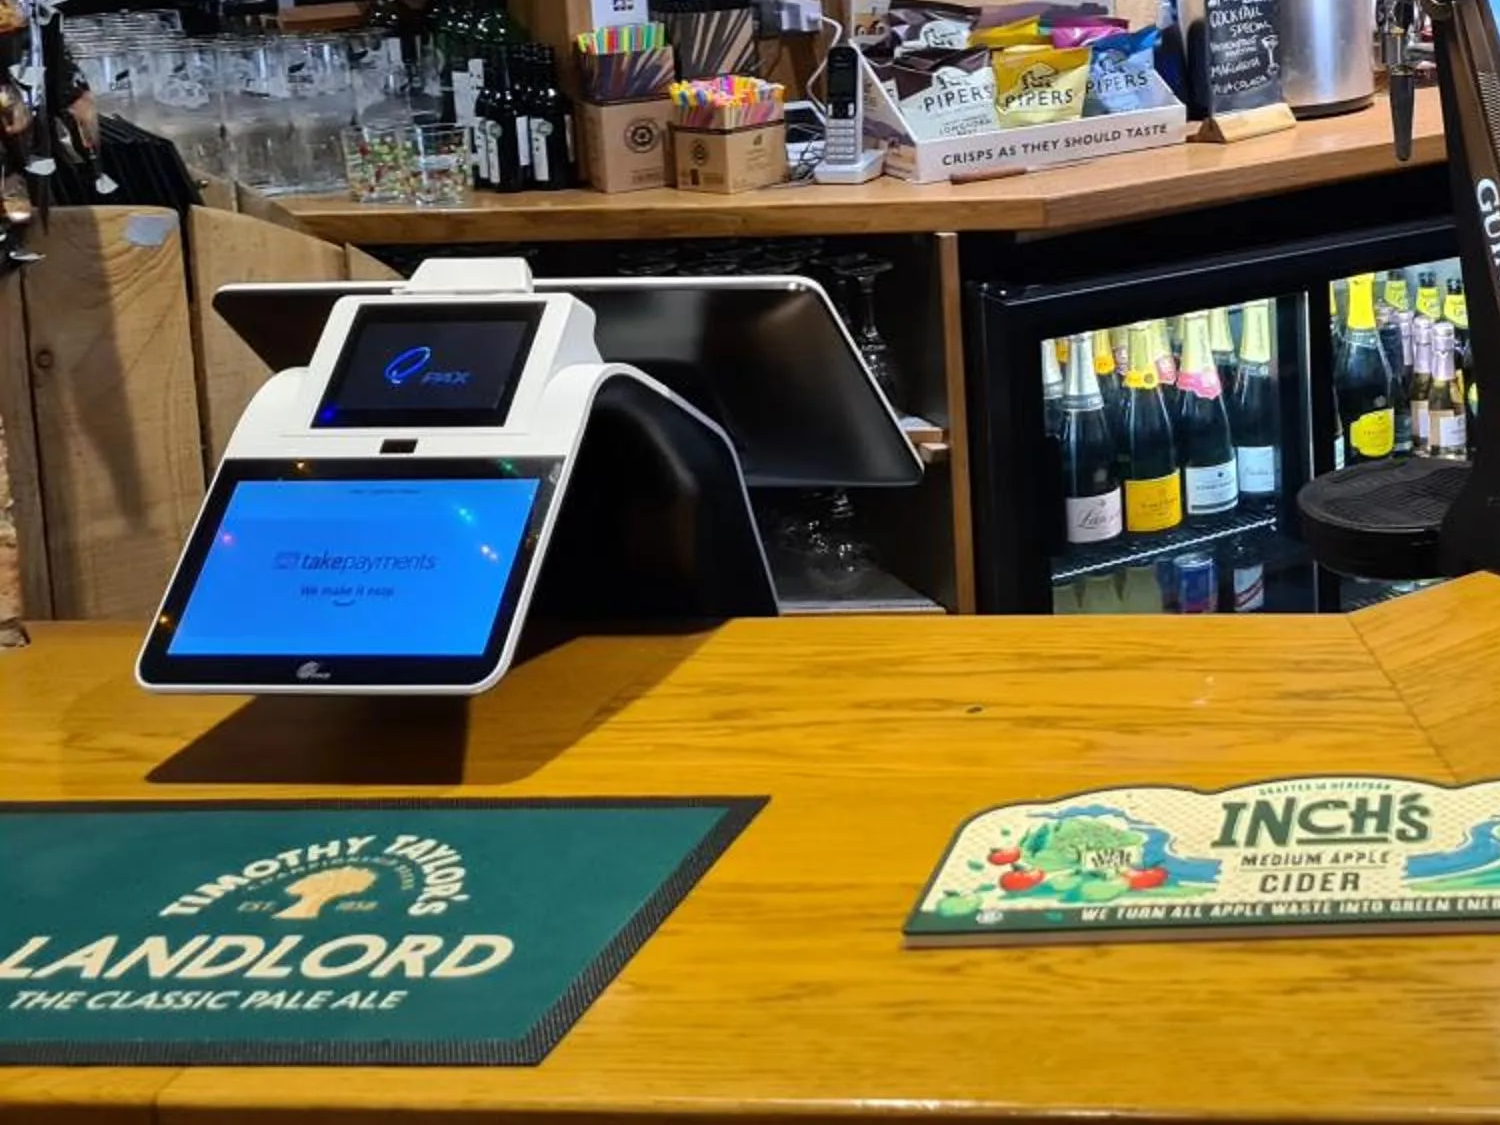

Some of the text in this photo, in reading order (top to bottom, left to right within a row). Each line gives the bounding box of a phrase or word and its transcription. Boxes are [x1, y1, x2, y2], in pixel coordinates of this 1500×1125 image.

[1086, 73, 1149, 94] PIPERS
[923, 84, 993, 112] PIPERS
[1003, 89, 1074, 109] PIPERS
[942, 124, 1168, 167] CRISPS AS THEY SHOULD TASTE
[420, 371, 469, 385] PAX
[301, 550, 437, 573] takepayments
[1210, 792, 1432, 848] INCH'S
[1240, 850, 1390, 867] MEDIUM APPLE
[159, 835, 470, 917] TIMOTHY TAYLOR'S
[1258, 872, 1361, 894] CIDER
[1081, 907, 1108, 921] WE
[1116, 906, 1167, 920] TURN
[1170, 905, 1203, 919] ALL
[1209, 903, 1264, 917] APPLE
[1271, 900, 1333, 915] WASTE
[1339, 899, 1384, 914] INTO
[1390, 898, 1450, 913] GREEN
[0, 935, 515, 979] LANDLORD
[8, 990, 409, 1011] THE CLASSIC PALE ALE
